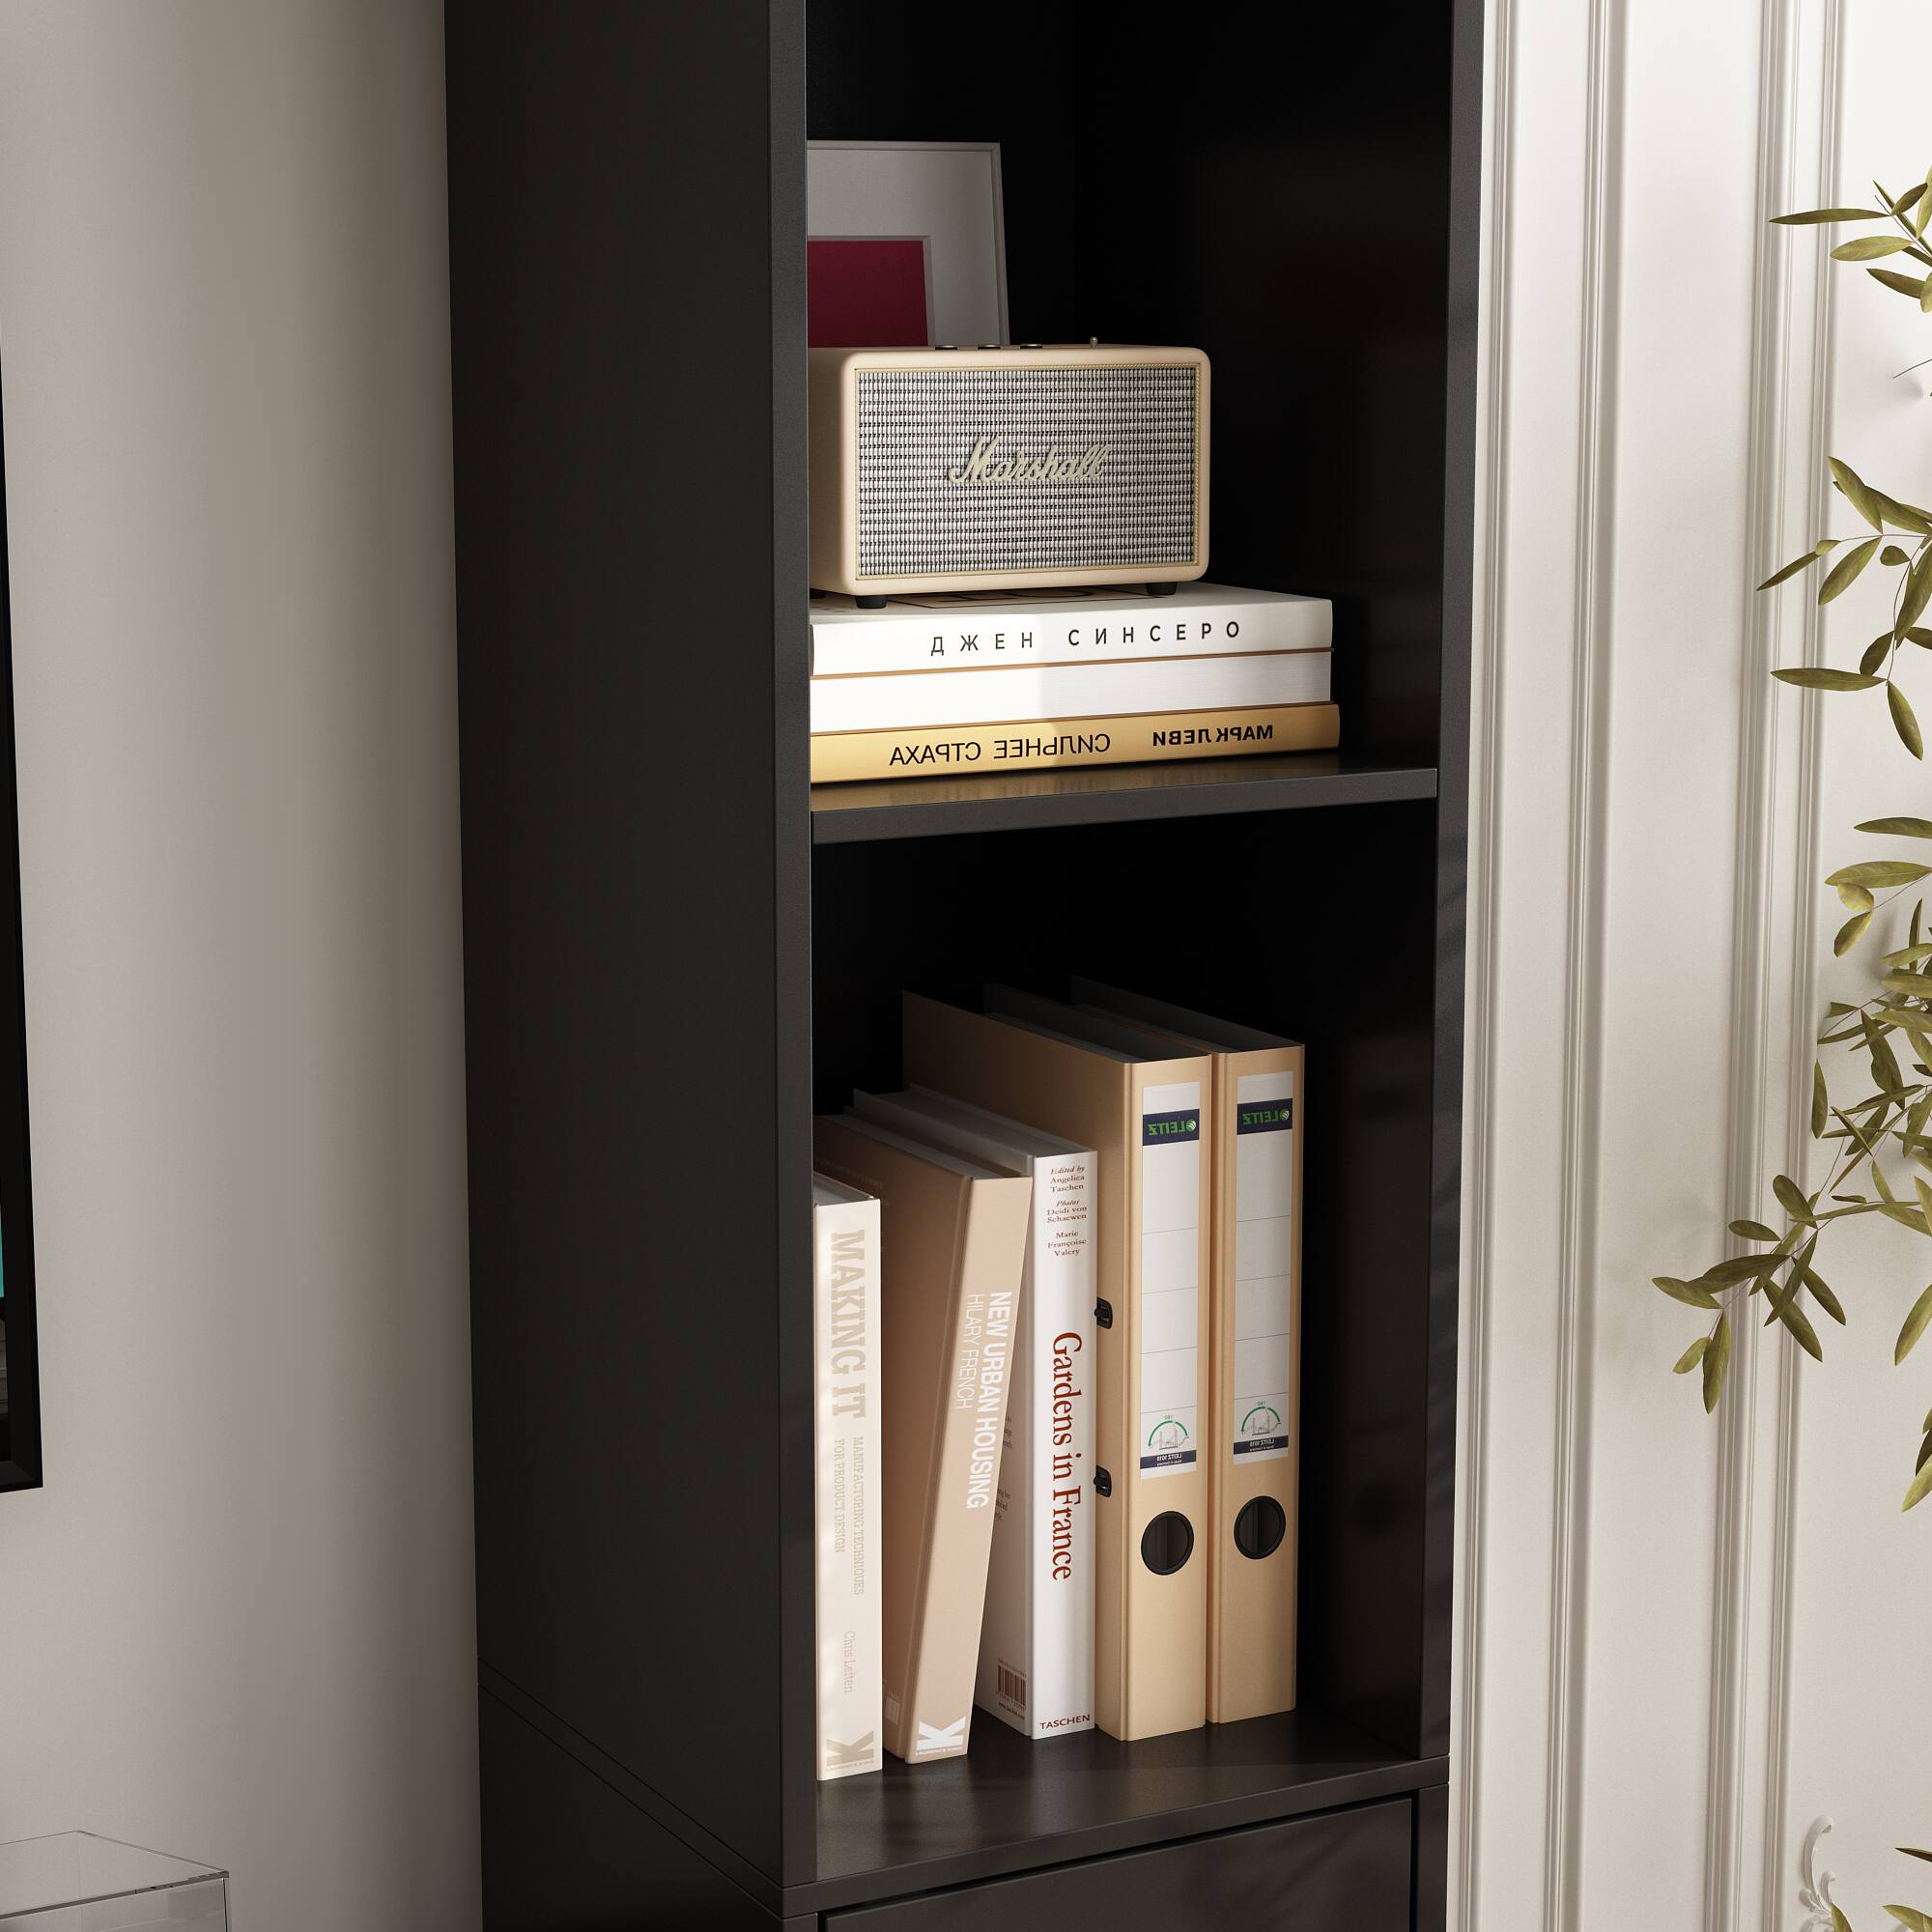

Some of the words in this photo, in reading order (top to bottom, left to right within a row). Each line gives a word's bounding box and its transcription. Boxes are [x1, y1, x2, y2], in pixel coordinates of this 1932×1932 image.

[949, 436, 1111, 483] Marshall
[930, 632, 1033, 656] ДЖЕН
[1067, 621, 1239, 645] СИНСЕРО
[1050, 1176, 1085, 1184] Angelica
[1050, 1184, 1084, 1193] Taschen
[1076, 1165, 1086, 1174] by
[831, 1229, 866, 1376] MAKING
[964, 1294, 986, 1346] HILARY
[986, 1292, 1012, 1337] NEW
[956, 1350, 979, 1410] FRENCH
[978, 1342, 1008, 1412] URBAN
[1053, 1331, 1082, 1446] Gardens
[832, 1383, 867, 1419] IT
[834, 1438, 845, 1461] FOR
[966, 1417, 998, 1509] HOUSING
[1052, 1452, 1082, 1480] in
[834, 1463, 845, 1512] PRODUCT
[853, 1436, 865, 1528] MANUFACTURING
[834, 1515, 845, 1553] DESIGN
[1052, 1486, 1082, 1580] France
[853, 1530, 865, 1596] TECHNIQUES
[843, 1631, 857, 1658] Chris
[1038, 1713, 1091, 1730] TASCHEN
